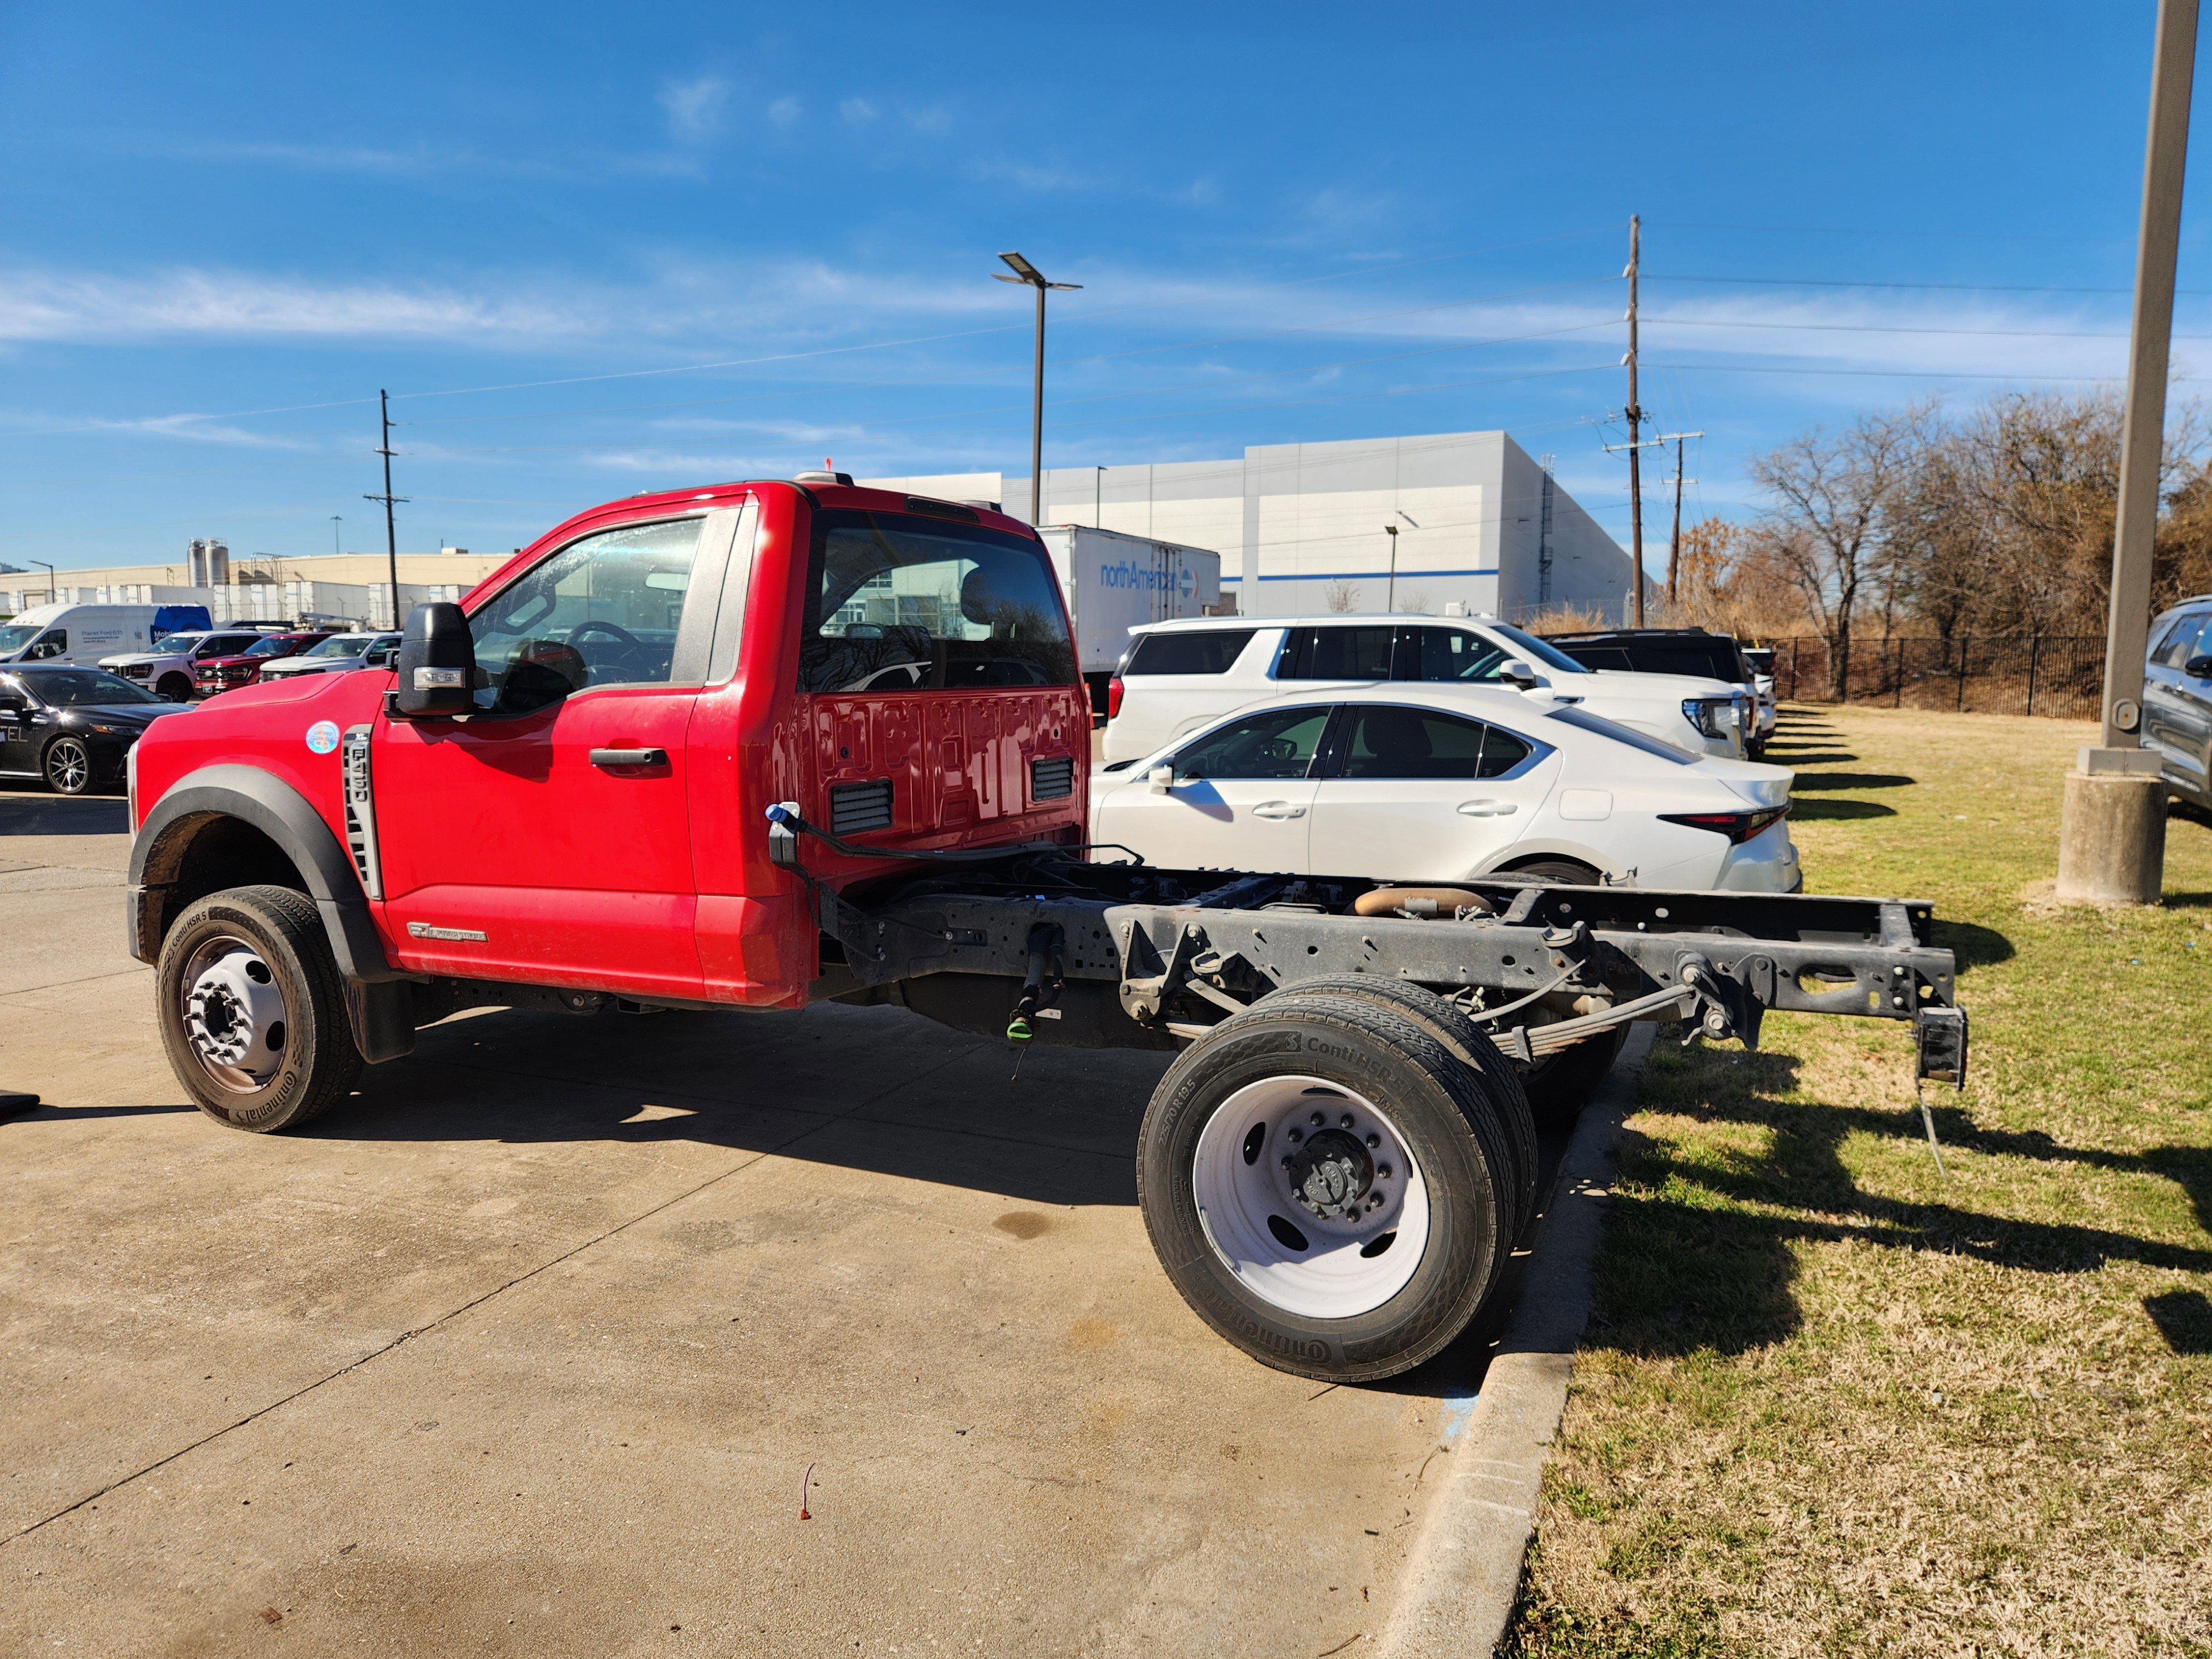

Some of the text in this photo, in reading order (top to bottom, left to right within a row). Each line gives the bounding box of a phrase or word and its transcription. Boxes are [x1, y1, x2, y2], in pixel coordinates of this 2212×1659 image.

[1100, 560, 1177, 592] northAmerican
[172, 911, 207, 947] Conti HSR 5
[1307, 1037, 1407, 1092] Conti HSR 5
[245, 1071, 298, 1124] Continental
[1202, 1287, 1333, 1365] Continental
